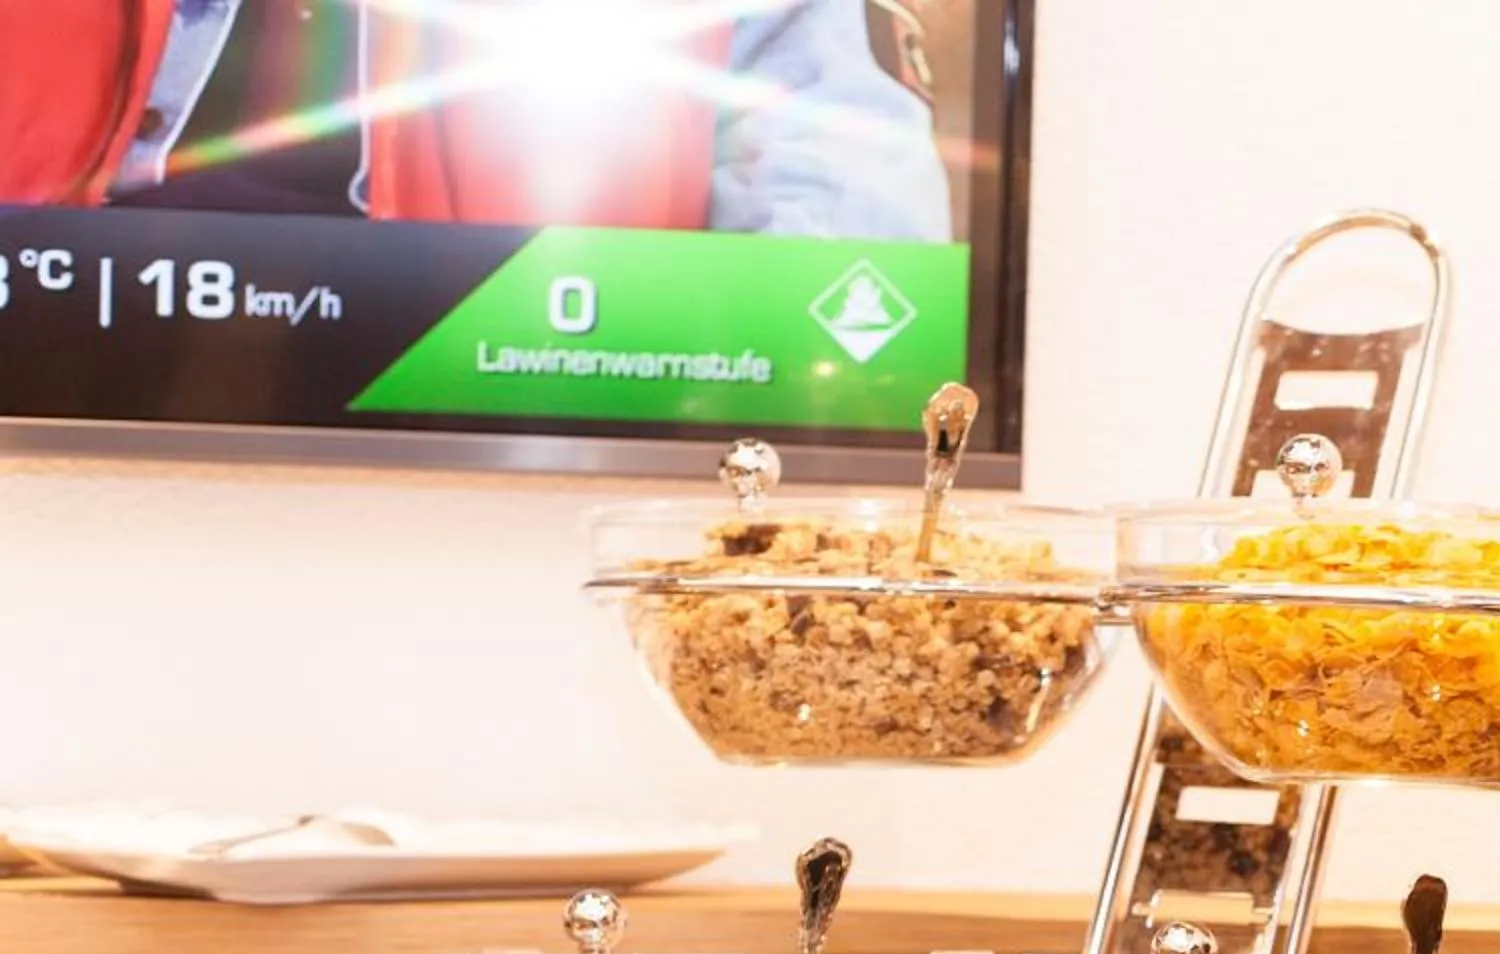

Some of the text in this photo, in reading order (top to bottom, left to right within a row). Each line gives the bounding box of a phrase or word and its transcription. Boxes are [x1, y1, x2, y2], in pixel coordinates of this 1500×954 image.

[138, 258, 236, 319] 18
[245, 284, 341, 325] km/h
[547, 275, 597, 335] 0
[476, 340, 773, 384] Lawinenwarnstufe
